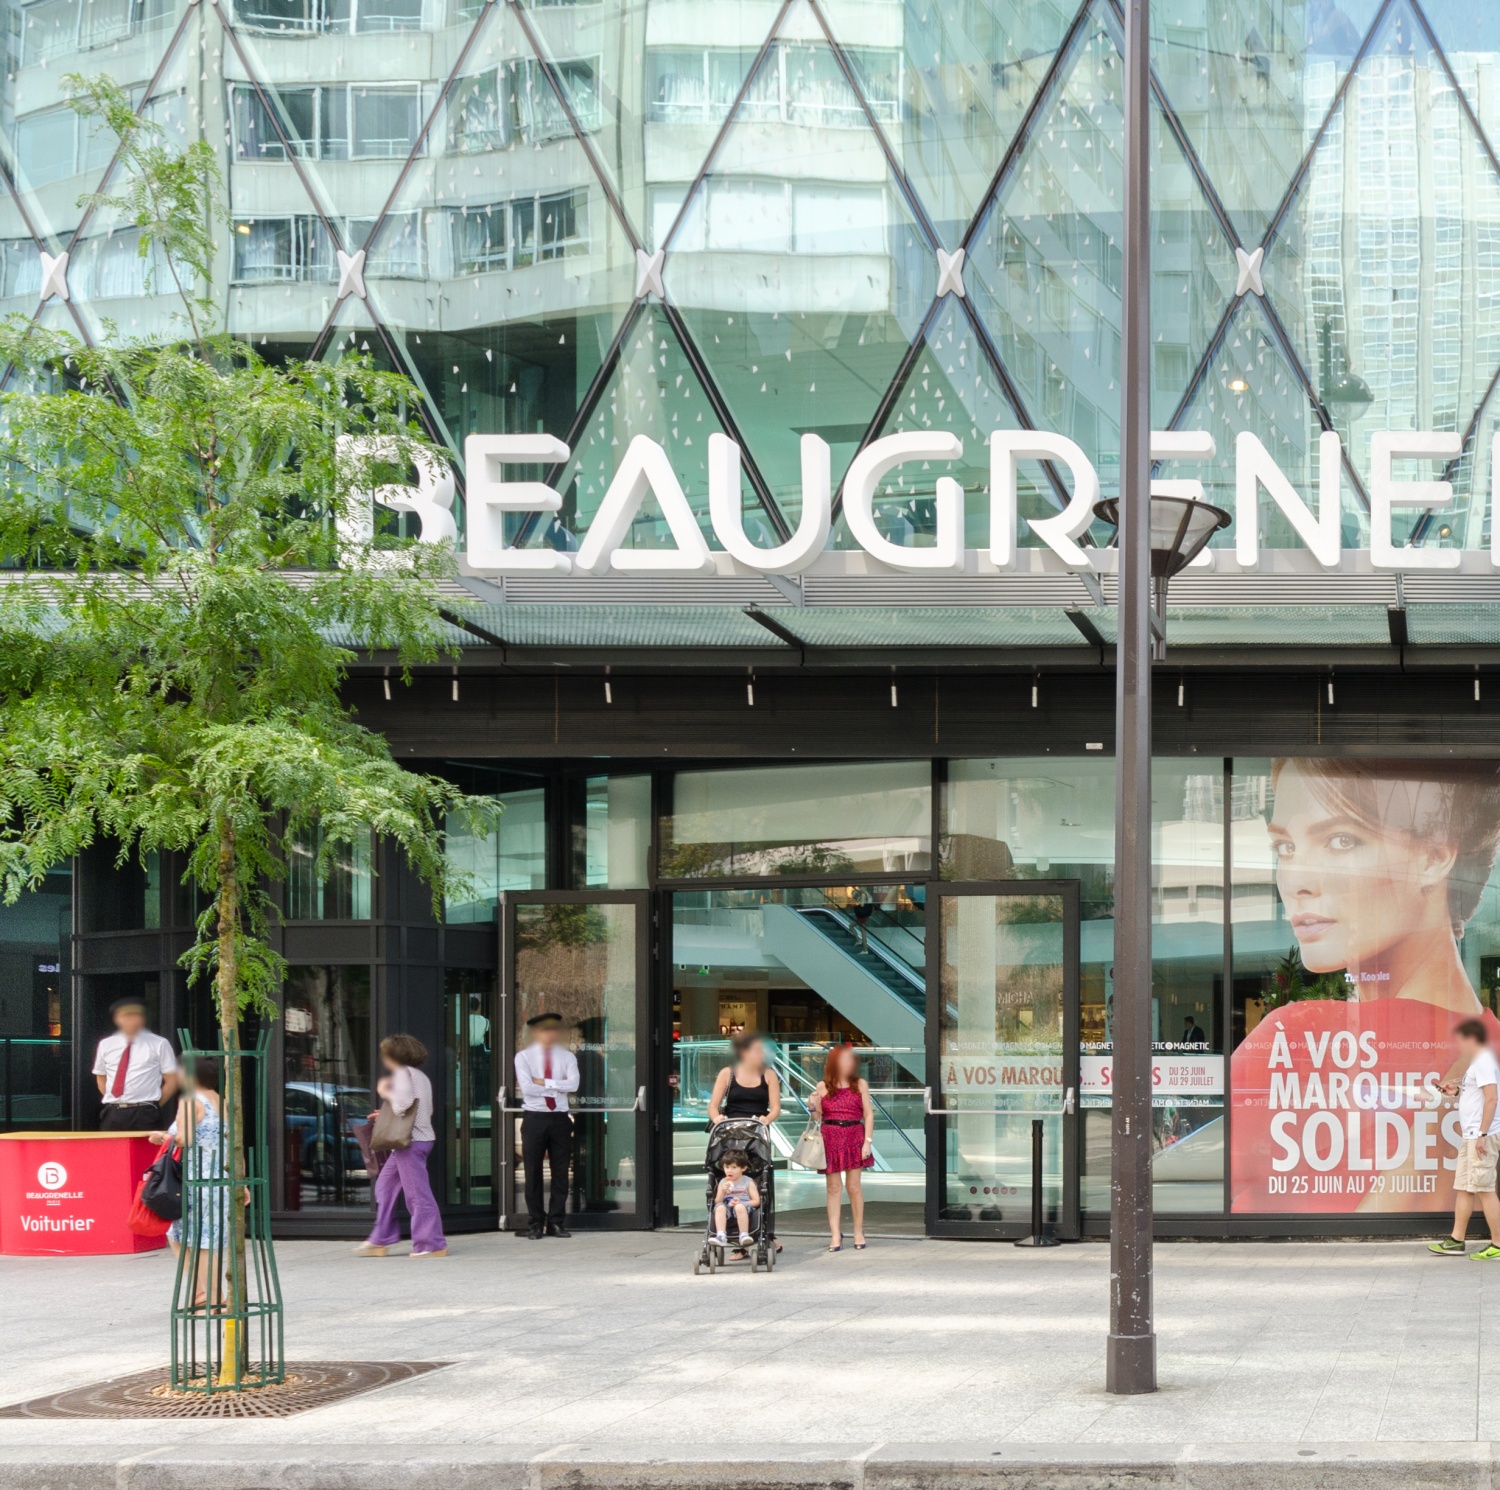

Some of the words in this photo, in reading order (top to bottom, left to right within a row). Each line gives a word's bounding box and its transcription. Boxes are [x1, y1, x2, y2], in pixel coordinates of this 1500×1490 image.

[1085, 1042, 1114, 1050] MAGNET
[1174, 1042, 1210, 1050] MAGNETIC
[1267, 1021, 1293, 1069] À
[1304, 1030, 1379, 1069] VOS
[1386, 1042, 1421, 1050] MAGNETIC
[946, 1062, 958, 1085] À
[963, 1066, 996, 1085] VOS
[1169, 1066, 1178, 1076] DU
[1180, 1066, 1189, 1076] 25
[1190, 1066, 1206, 1076] JUIN
[1169, 1076, 1178, 1086] AU
[1180, 1076, 1189, 1086] 29
[1190, 1076, 1214, 1086] JUILLET
[1270, 1111, 1460, 1172] SOLDES
[1268, 1175, 1287, 1194] DU
[1291, 1175, 1309, 1194] 25
[1311, 1175, 1343, 1194] JUIN
[1346, 1175, 1365, 1194] AU
[1369, 1175, 1386, 1194] 29
[1389, 1174, 1438, 1194] JUILLET
[26, 1191, 84, 1199] BEAUGRENELLE
[20, 1215, 95, 1232] Voiturier
